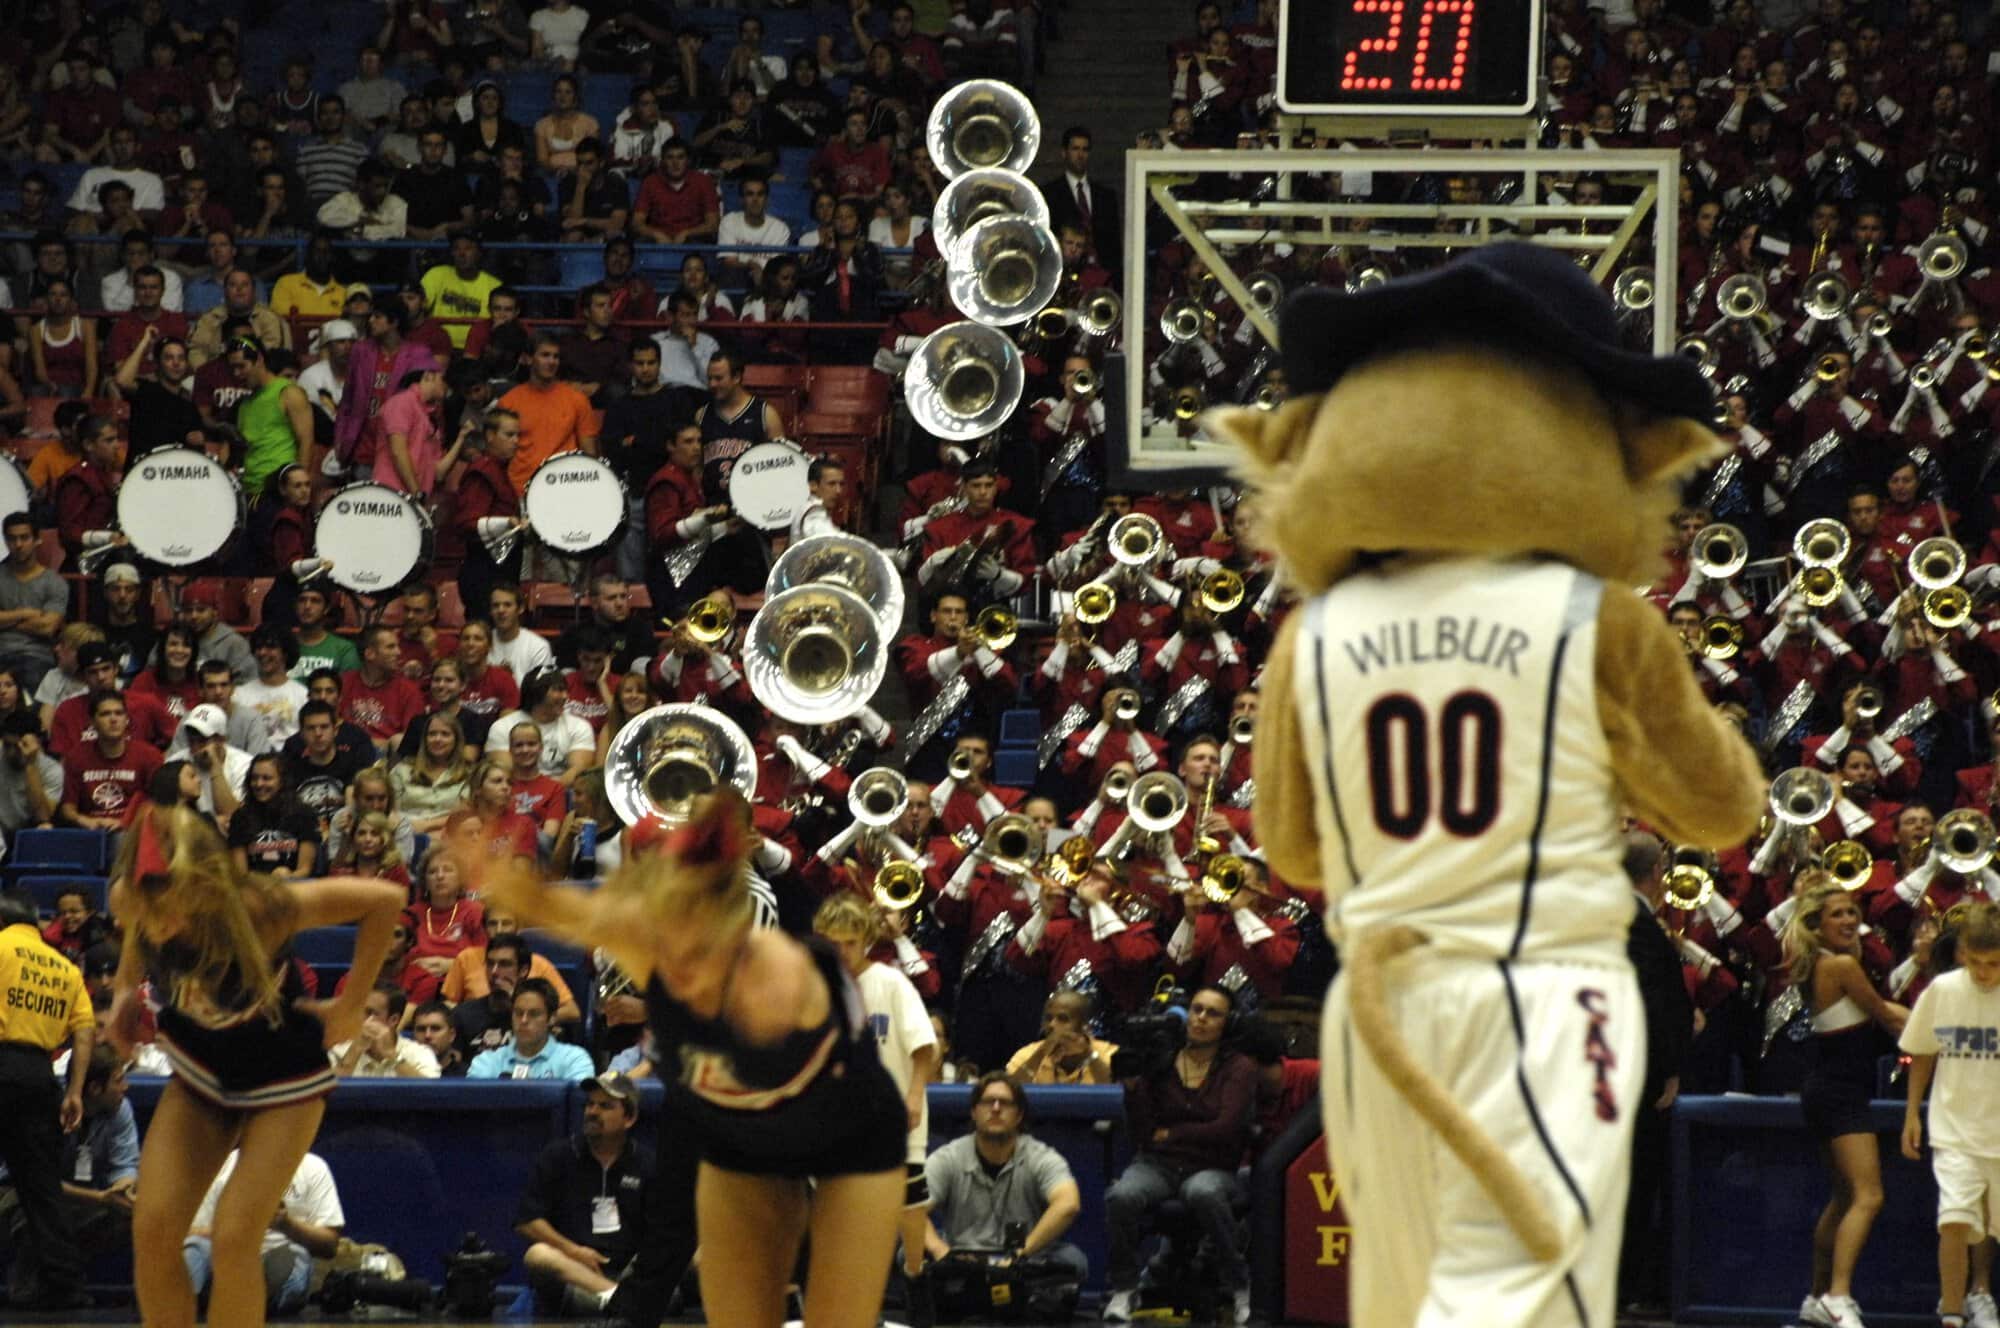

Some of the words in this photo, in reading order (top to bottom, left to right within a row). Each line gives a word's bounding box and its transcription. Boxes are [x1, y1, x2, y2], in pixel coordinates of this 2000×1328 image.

[1340, 0, 1475, 90] 20
[159, 465, 210, 480] YAMAHA
[753, 455, 795, 472] YAMAHA
[560, 470, 599, 484] YAMAHA
[353, 502, 402, 517] YAMAHA
[1343, 616, 1530, 677] WILBUR
[1365, 690, 1503, 840] 00
[15, 948, 69, 973] EVENT
[21, 966, 70, 991] STAFF
[7, 987, 67, 1020] SECURIT
